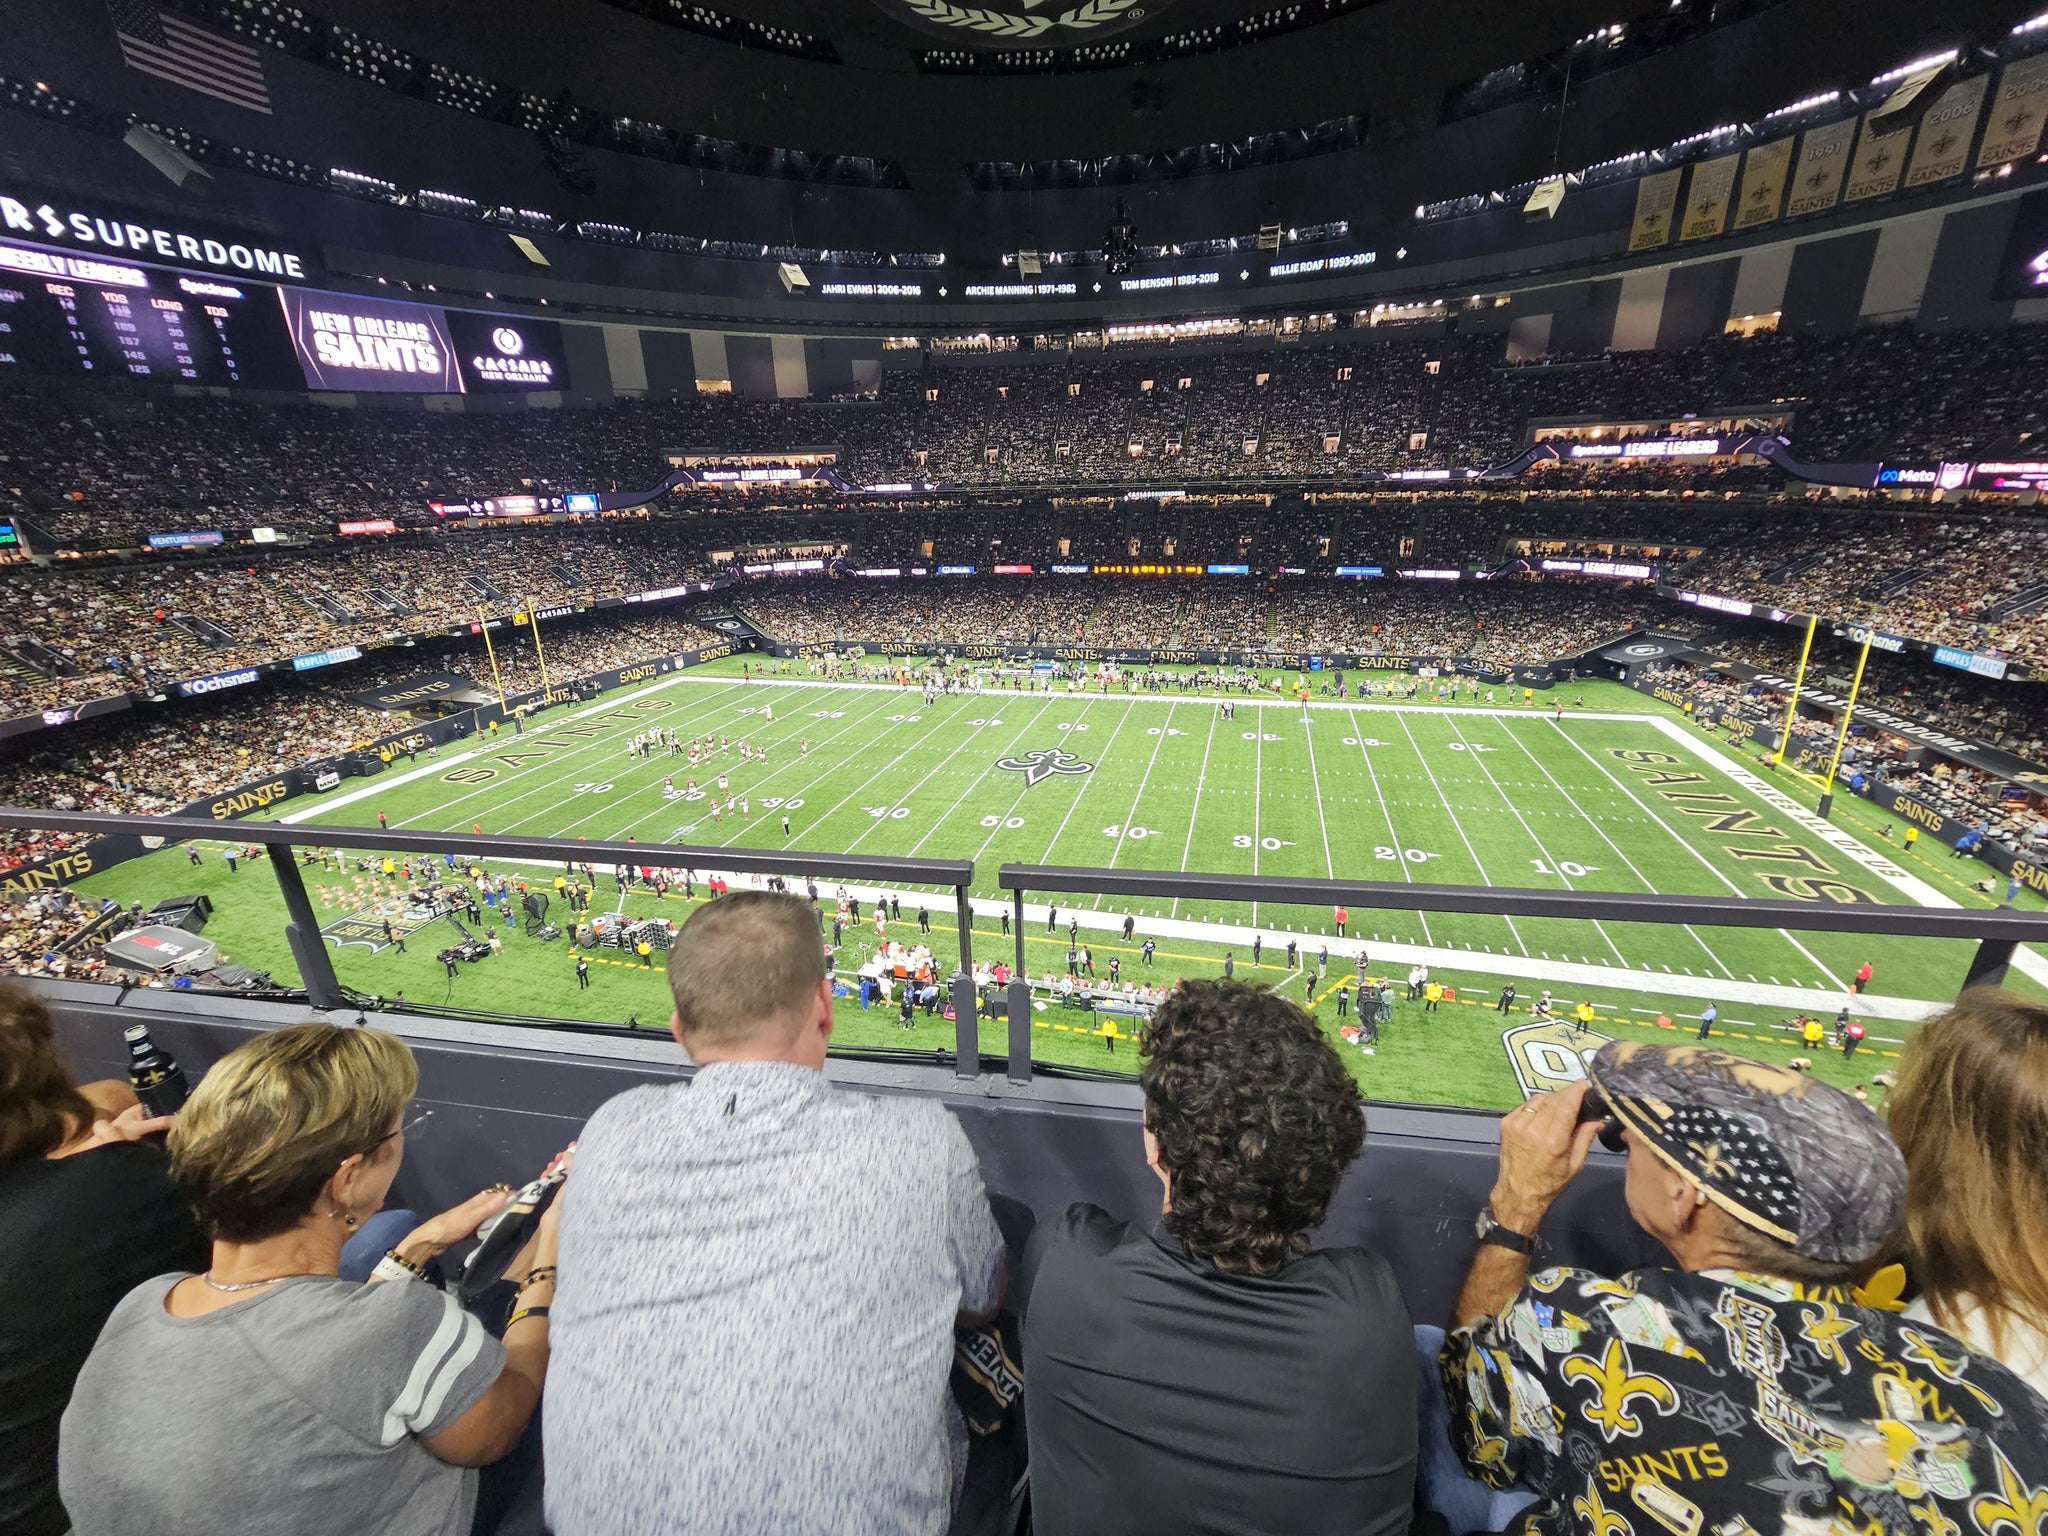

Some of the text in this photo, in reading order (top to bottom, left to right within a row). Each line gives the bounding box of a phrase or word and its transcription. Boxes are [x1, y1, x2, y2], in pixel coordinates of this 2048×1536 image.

[1931, 101, 1974, 125] 2006
[1808, 142, 1840, 161] 1991
[1983, 140, 2037, 165] SAINTS
[1910, 163, 1961, 186] SAINTS
[1848, 180, 1894, 200] SAINTS
[1790, 196, 1834, 214] SAINTS
[69, 213, 305, 278] SUPERDOME
[67, 258, 148, 288] LEADERS
[1270, 252, 1376, 277] WILLIE ROAF 1993-2001
[179, 278, 242, 298] Spectrum
[821, 284, 922, 296] JAHRI EVANS 2006-2016
[965, 284, 1076, 295] ARCHIE MANNING 1971-1982
[1121, 273, 1219, 291] TOM BENSON 1985-2018
[46, 283, 229, 318] REC YDS LONG TDS
[309, 310, 430, 341] NEW ORLEANS
[70, 330, 87, 341] 11
[119, 336, 140, 346] 157
[223, 347, 232, 356] 0
[313, 330, 441, 374] SAINTS
[129, 364, 151, 375] 125
[181, 368, 198, 379] 32
[231, 372, 240, 381] 0
[227, 360, 236, 369] 0
[473, 356, 553, 375] CAESARS
[481, 370, 549, 384] NEW ORLEANS
[1573, 440, 1719, 457] Spectrum LEAGUE LEADERS
[703, 469, 801, 481] Spectrum LEAGUE LEADERS
[1899, 470, 1935, 482] Meta
[151, 533, 222, 545] VENTURE GLOBAL
[1058, 565, 1087, 574] Ochsner
[1543, 560, 1650, 577] Spectrum LEAGUE LEADERS
[536, 606, 572, 619] CAESARS
[700, 646, 731, 662] SAINTS
[880, 643, 917, 655] SAINTS
[1055, 649, 1098, 660] SAINTS
[1150, 651, 1196, 664] SAINTS
[295, 648, 357, 670] PEOPLES HEALTH
[1359, 657, 1410, 669] SAINTS
[1936, 648, 2004, 675] PEOPLES HEALTH
[193, 670, 257, 694] Ochsner
[378, 680, 450, 705] SAINTS
[1654, 686, 1683, 706] SAINTS
[1720, 713, 1755, 737] SAINTS
[1845, 702, 1980, 753] SUPERDOME
[440, 699, 676, 784] SAINTS
[211, 779, 288, 818] SAINTS
[868, 806, 910, 819] 40
[980, 815, 1025, 829] 50
[1893, 796, 1944, 832] SAINTS
[1101, 824, 1148, 839] 40
[1604, 747, 1890, 905] SAINTS
[1746, 777, 1805, 811] TAKES
[1795, 812, 1838, 836] ALL
[1834, 839, 1874, 855] OF
[1865, 860, 1909, 878] US
[1232, 835, 1281, 850] 30
[1373, 846, 1428, 863] 20
[1531, 859, 1587, 877] 10
[1737, 1303, 1771, 1379] SAINTS
[1599, 1442, 1729, 1493] SAINTS
